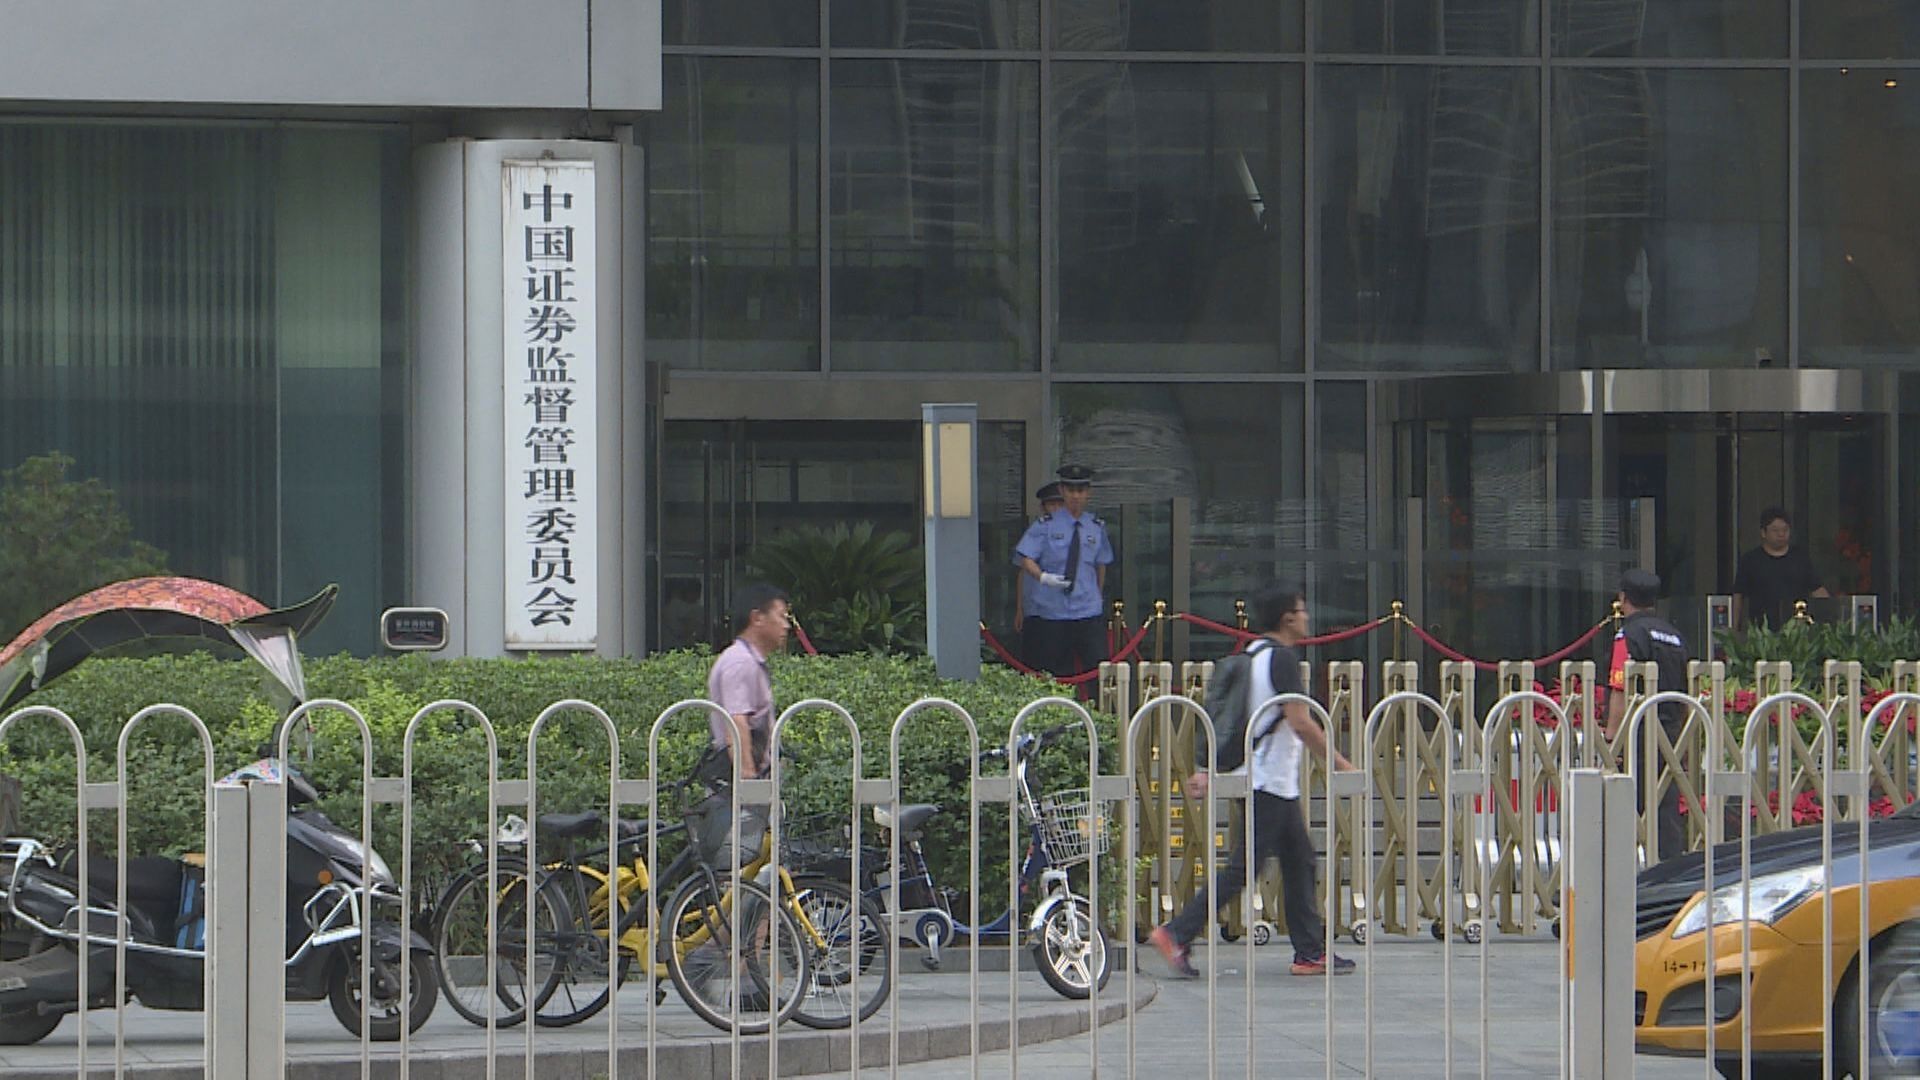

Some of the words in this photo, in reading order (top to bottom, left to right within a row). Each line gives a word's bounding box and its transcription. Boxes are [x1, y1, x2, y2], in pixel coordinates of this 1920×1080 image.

[523, 185, 577, 627] 中国证券监督管理委员会
